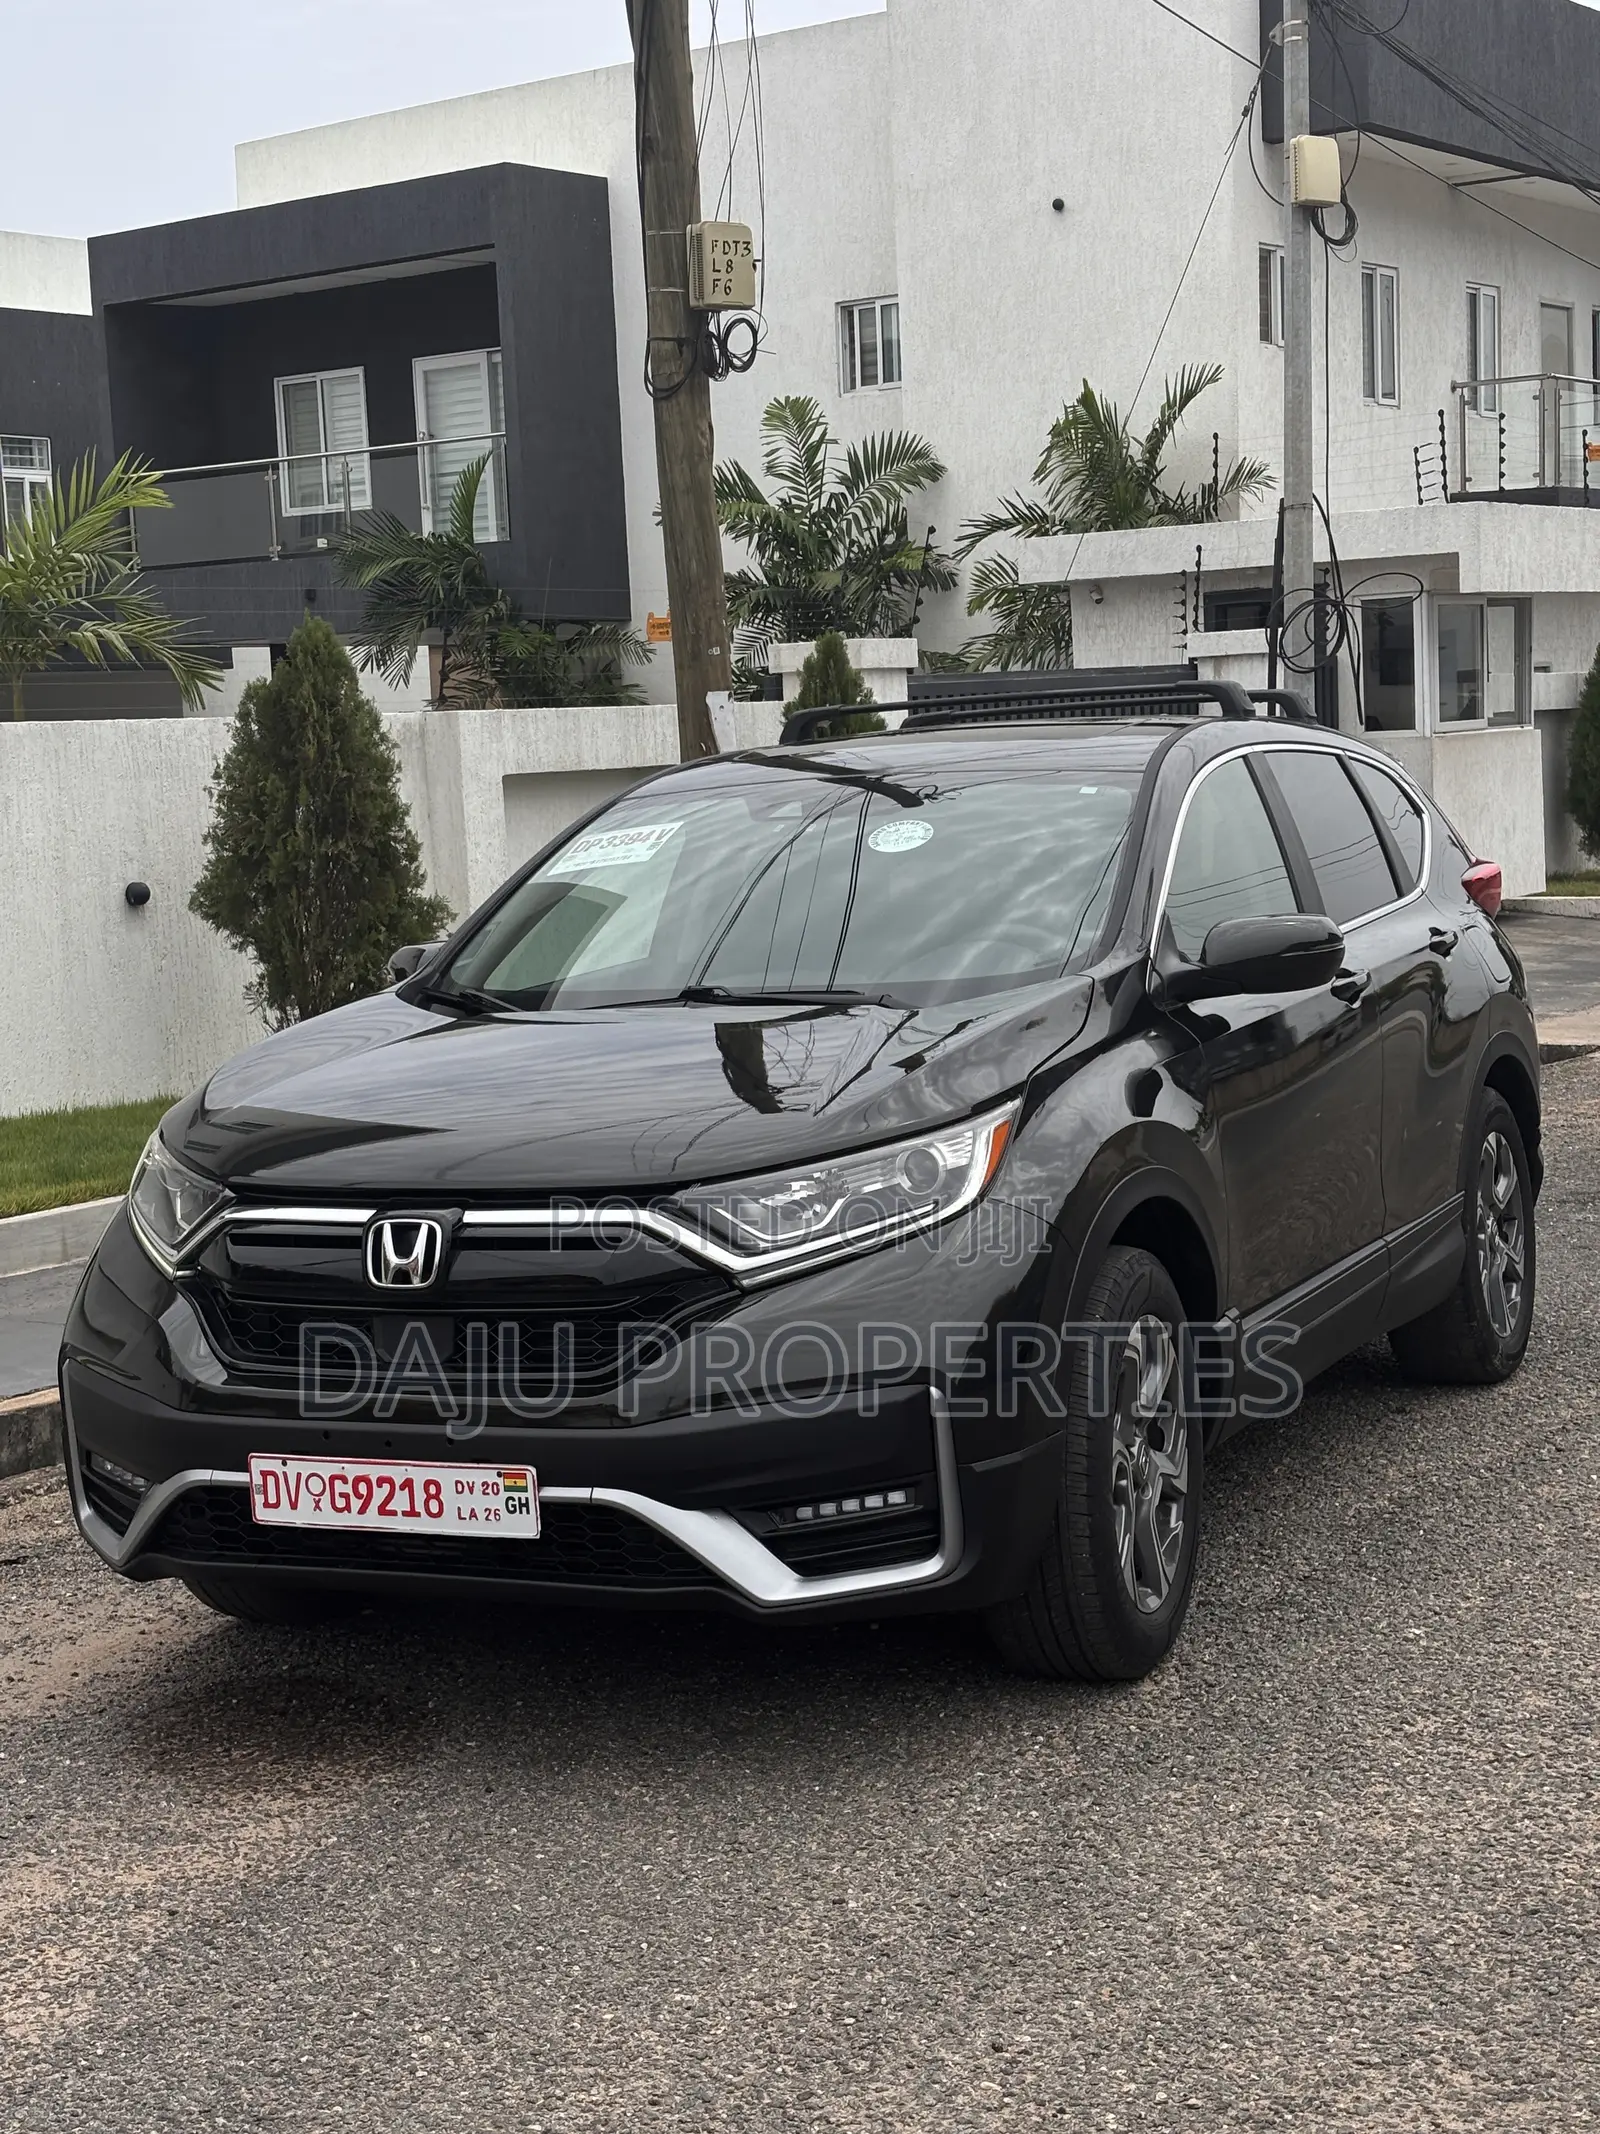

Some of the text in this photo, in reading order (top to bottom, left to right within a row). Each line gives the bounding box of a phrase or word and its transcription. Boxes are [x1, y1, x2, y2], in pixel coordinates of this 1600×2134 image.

[711, 239, 751, 257] FDT3
[712, 258, 734, 274] L8
[711, 279, 733, 296] F6
[454, 1479, 500, 1496] DV 20
[457, 1506, 501, 1521] LA 26
[505, 1496, 530, 1515] GH
